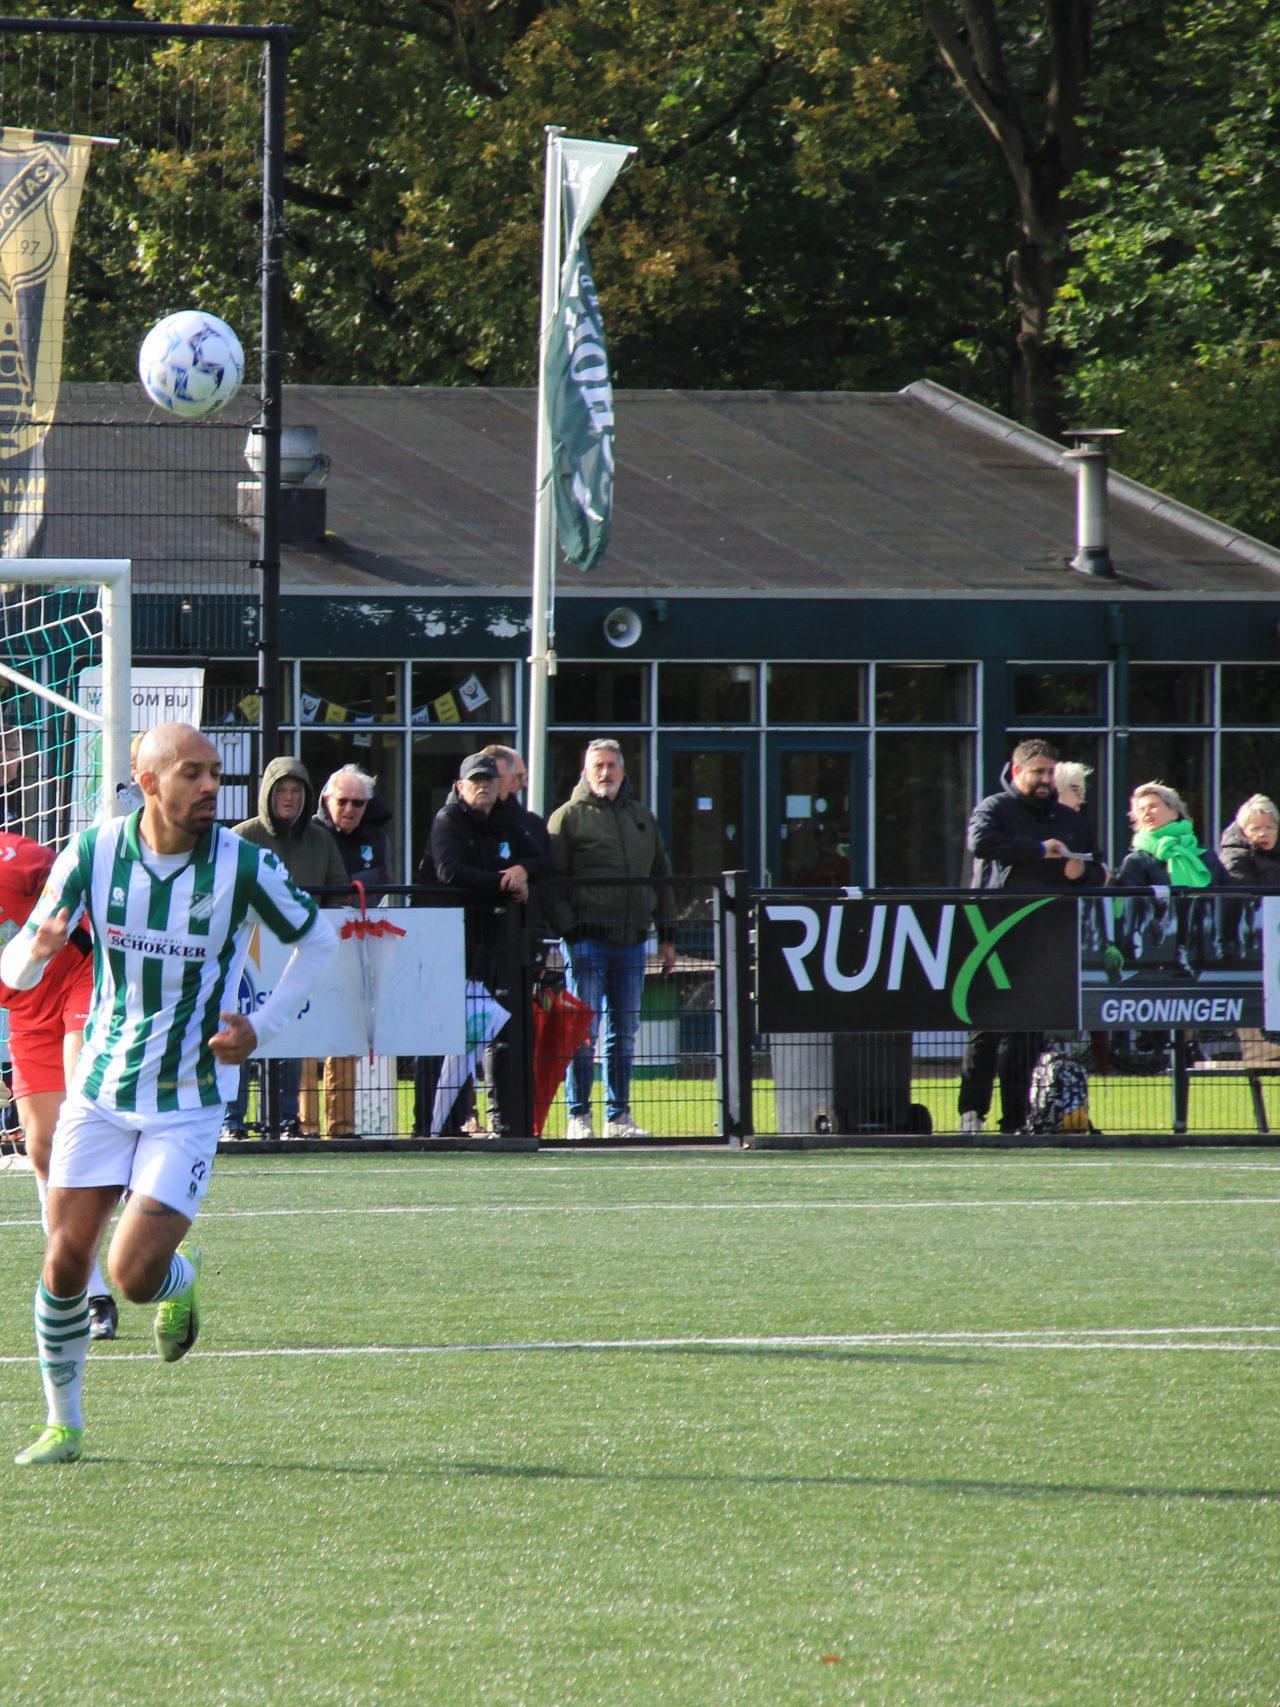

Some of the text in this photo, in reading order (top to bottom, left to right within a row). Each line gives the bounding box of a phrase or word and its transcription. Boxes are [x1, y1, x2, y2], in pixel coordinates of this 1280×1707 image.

[20, 239, 41, 256] 97
[164, 694, 189, 707] BIJ
[111, 935, 207, 958] SCHOKKER
[765, 896, 1058, 1025] RUNX
[1101, 998, 1245, 1023] GRONINGEN
